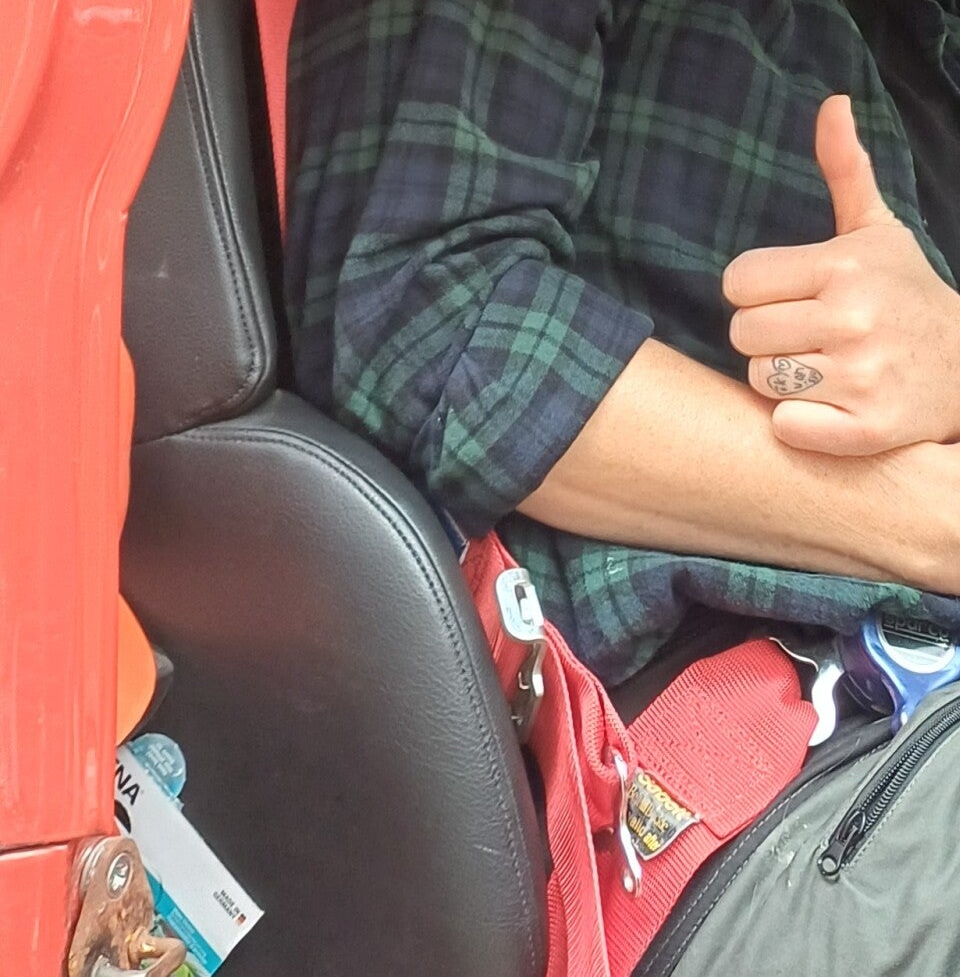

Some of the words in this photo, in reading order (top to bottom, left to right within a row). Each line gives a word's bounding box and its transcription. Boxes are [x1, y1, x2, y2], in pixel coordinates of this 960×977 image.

[115, 759, 140, 805] NA
[213, 891, 237, 918] GERMANY
[219, 889, 235, 906] MADE
